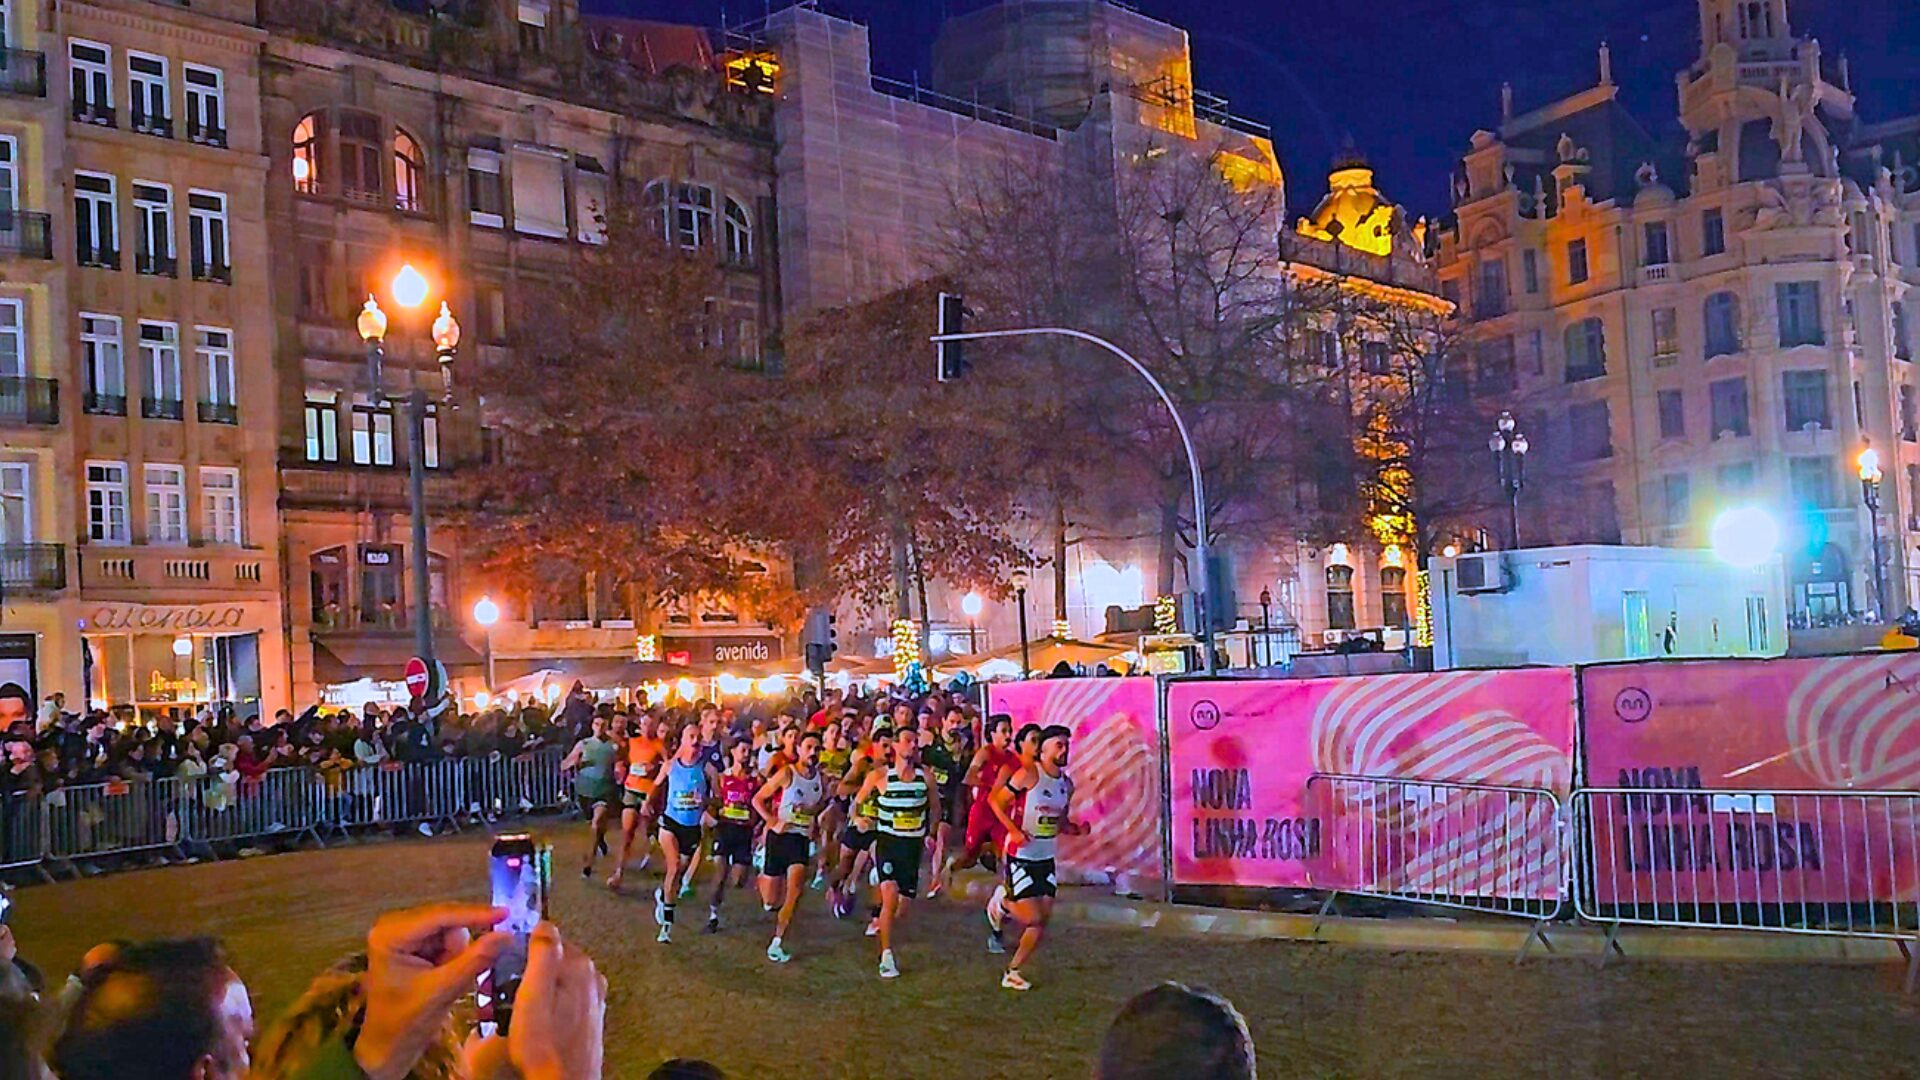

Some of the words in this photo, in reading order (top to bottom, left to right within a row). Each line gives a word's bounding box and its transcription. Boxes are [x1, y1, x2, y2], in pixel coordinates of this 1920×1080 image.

[715, 641, 769, 661] avenida
[1192, 768, 1251, 810] NOVA
[1618, 766, 1708, 815] NOVA
[1193, 817, 1257, 859] LINHA
[1262, 817, 1321, 860] ROSA
[1623, 823, 1720, 873] LINHA
[1728, 821, 1822, 873] ROSA
